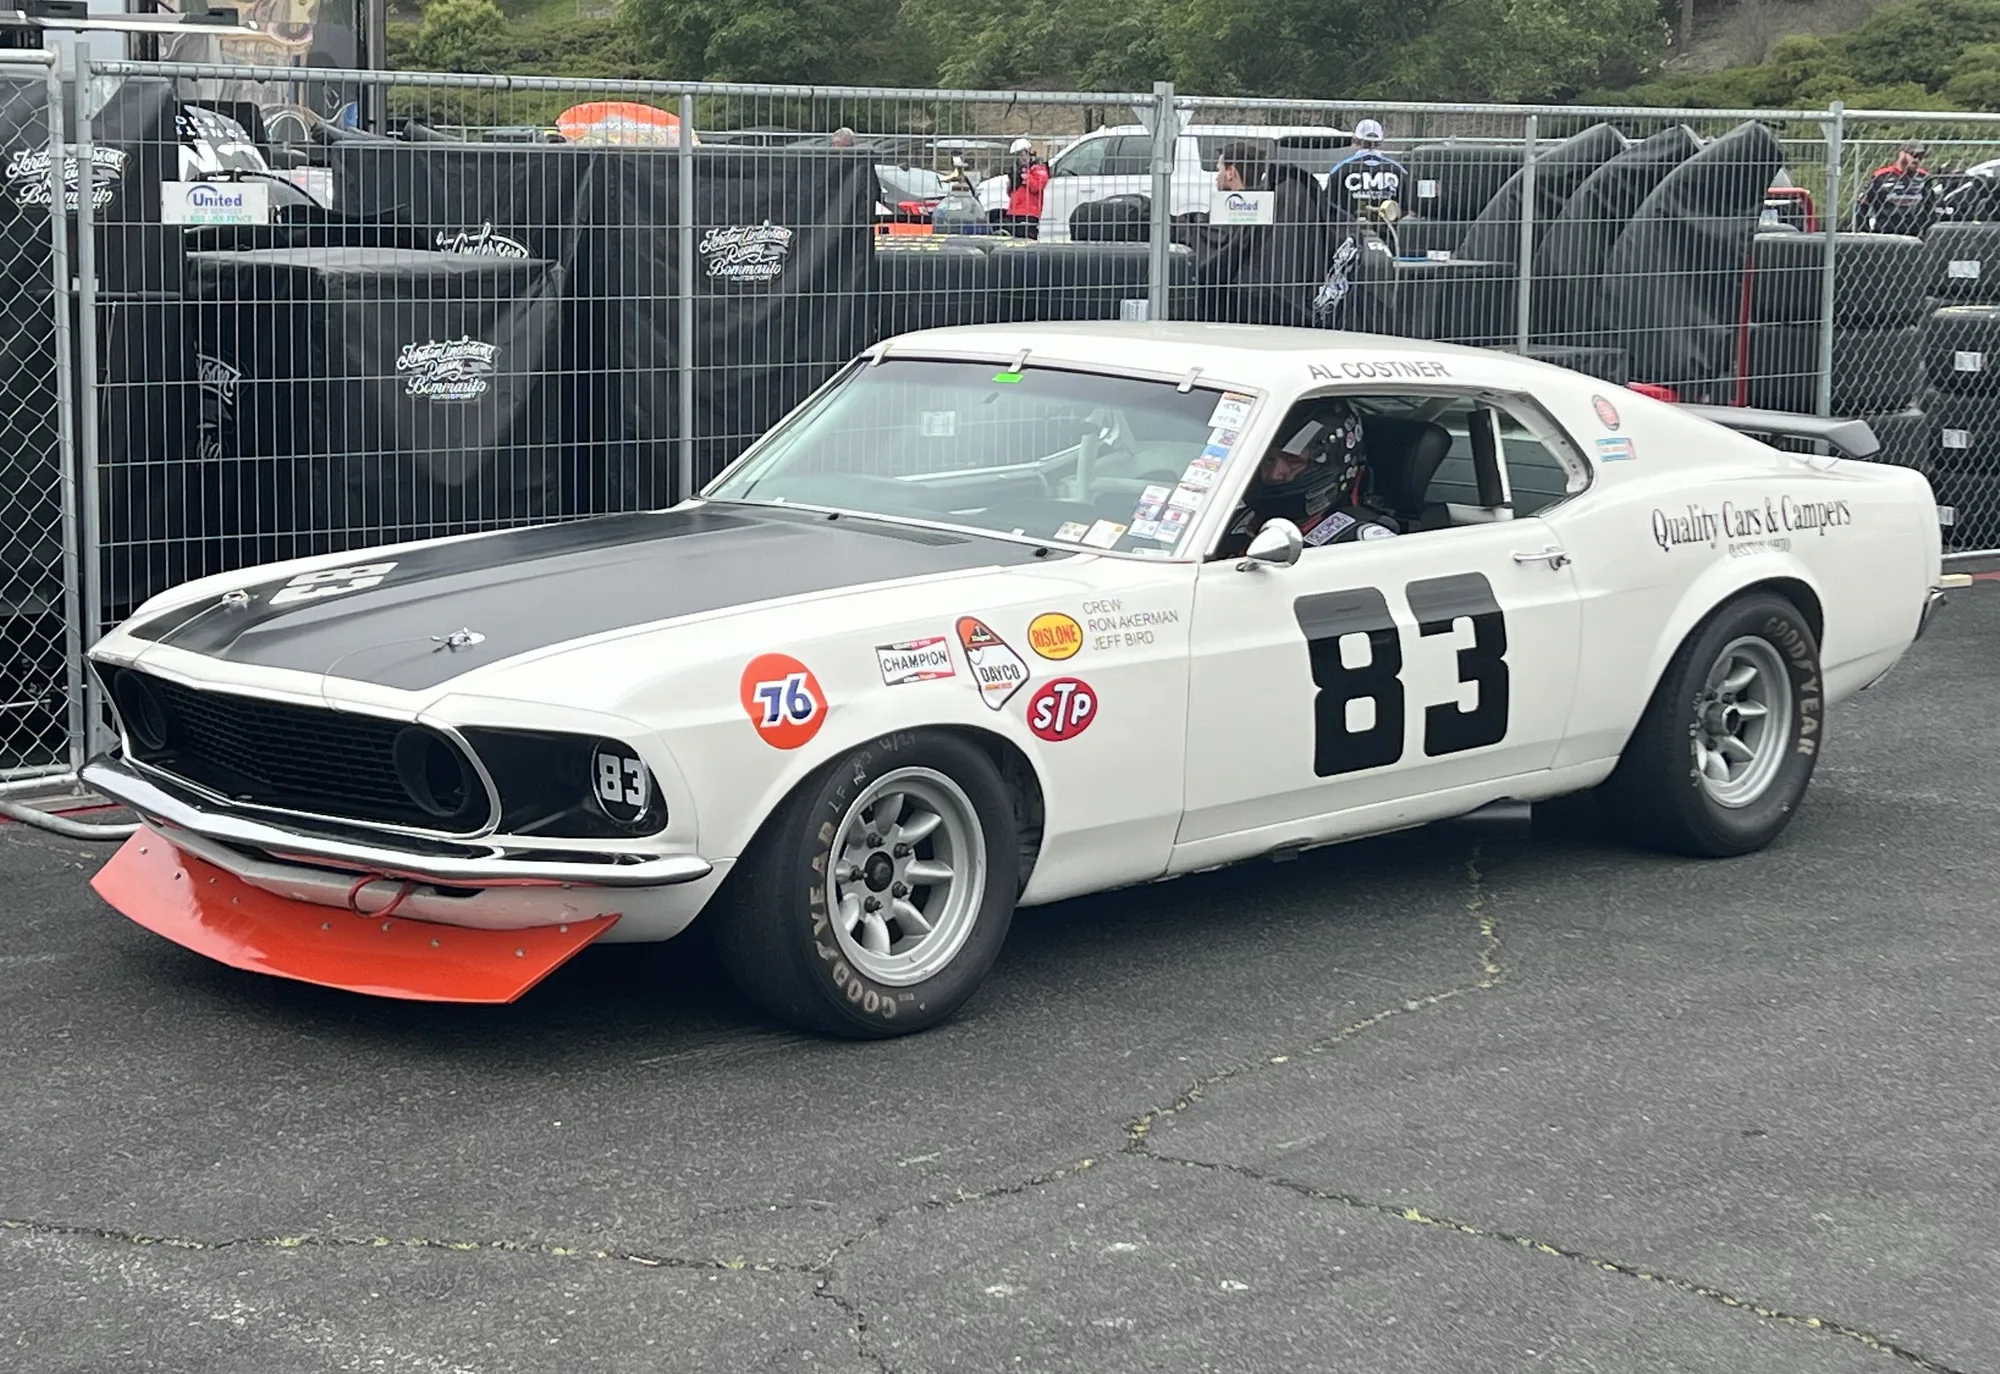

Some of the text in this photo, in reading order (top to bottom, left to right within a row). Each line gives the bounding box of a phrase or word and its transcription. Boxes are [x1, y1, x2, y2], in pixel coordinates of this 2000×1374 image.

[193, 193, 242, 207] United
[1307, 361, 1453, 380] AL COSTNER
[1652, 494, 1852, 553] Quality Cars & Campers
[268, 561, 399, 605] 83
[1032, 624, 1078, 648] RISLONE
[1087, 610, 1179, 632] RON AKERMAN
[1093, 631, 1155, 651] JEFF BIRD
[883, 650, 947, 672] CHAMPION
[979, 664, 1021, 683] DAYCO
[1293, 571, 1509, 778] 83
[754, 674, 816, 726] 76
[1764, 616, 1820, 756] GOODYEAR
[1033, 682, 1092, 732] STP
[598, 752, 646, 807] 83
